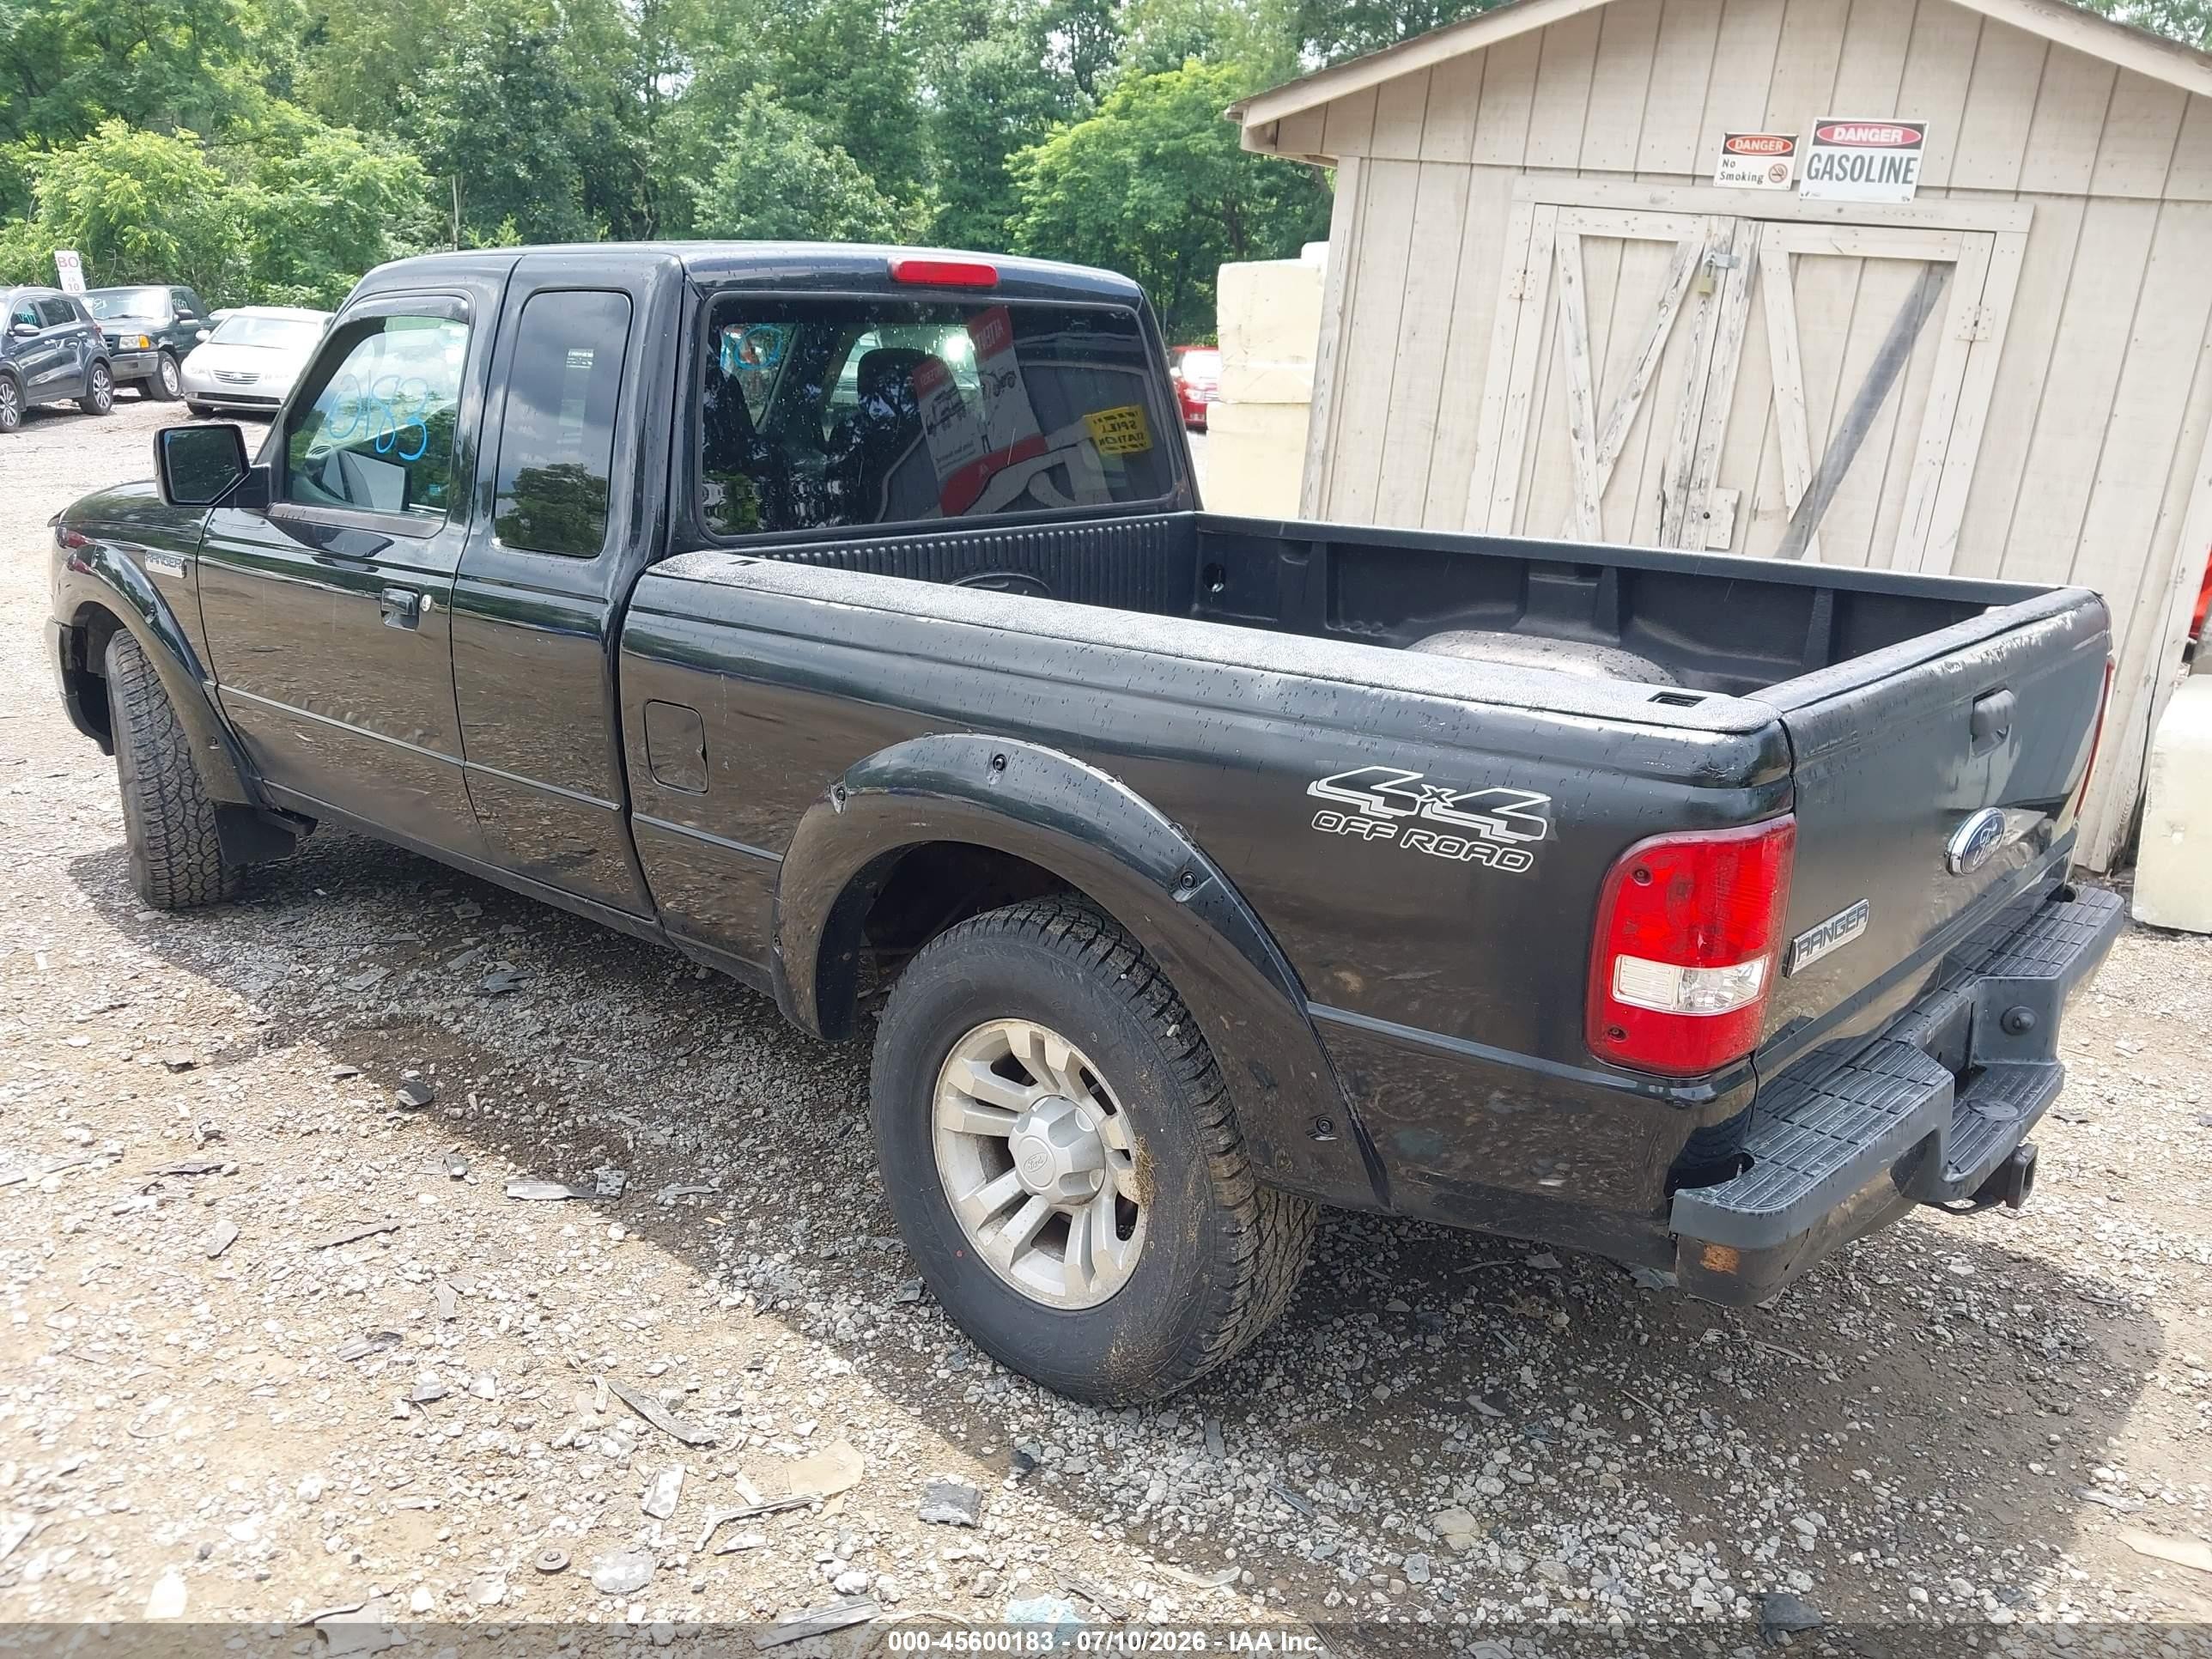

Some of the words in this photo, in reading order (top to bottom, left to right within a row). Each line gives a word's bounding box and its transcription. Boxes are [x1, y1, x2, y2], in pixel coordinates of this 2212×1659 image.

[1735, 138, 1784, 151] DANGER
[1832, 126, 1904, 143] DANGER
[1722, 158, 1736, 168] No
[1806, 153, 1918, 185] GASOLINE
[1719, 171, 1765, 185] Smoking
[329, 368, 429, 461] 0183
[1310, 810, 1399, 841] OFF
[1400, 828, 1534, 873] ROAD
[1796, 903, 1869, 963] RANGER
